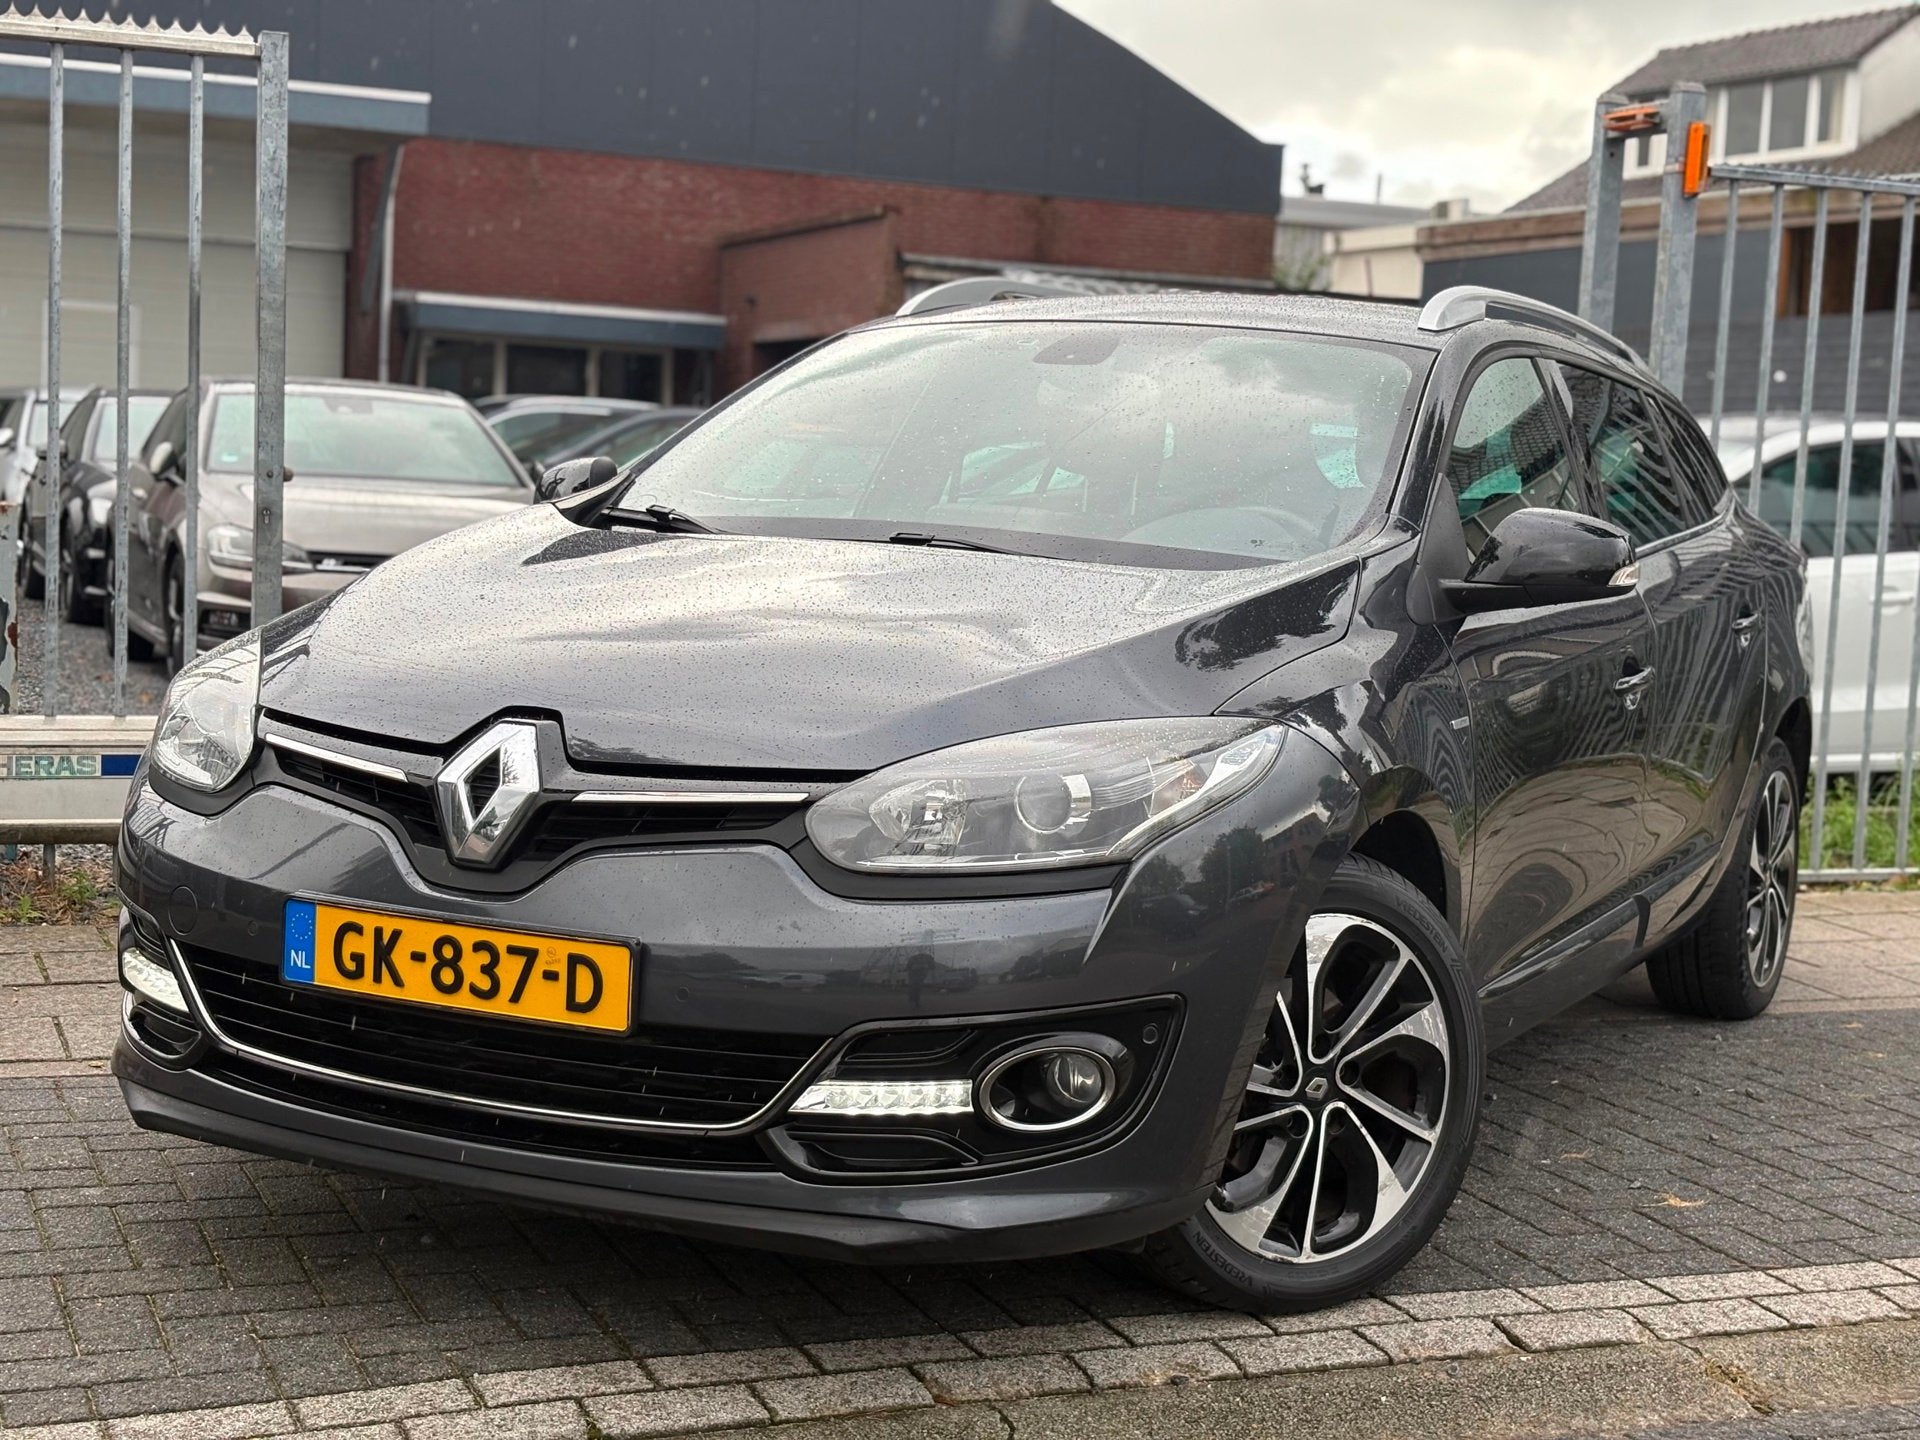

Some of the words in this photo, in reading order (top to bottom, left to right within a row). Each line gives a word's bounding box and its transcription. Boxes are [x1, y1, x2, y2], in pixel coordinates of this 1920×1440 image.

[290, 949, 311, 969] NL
[333, 920, 604, 1014] GK-837-D
[1193, 1230, 1253, 1287] VREDESTEIN
